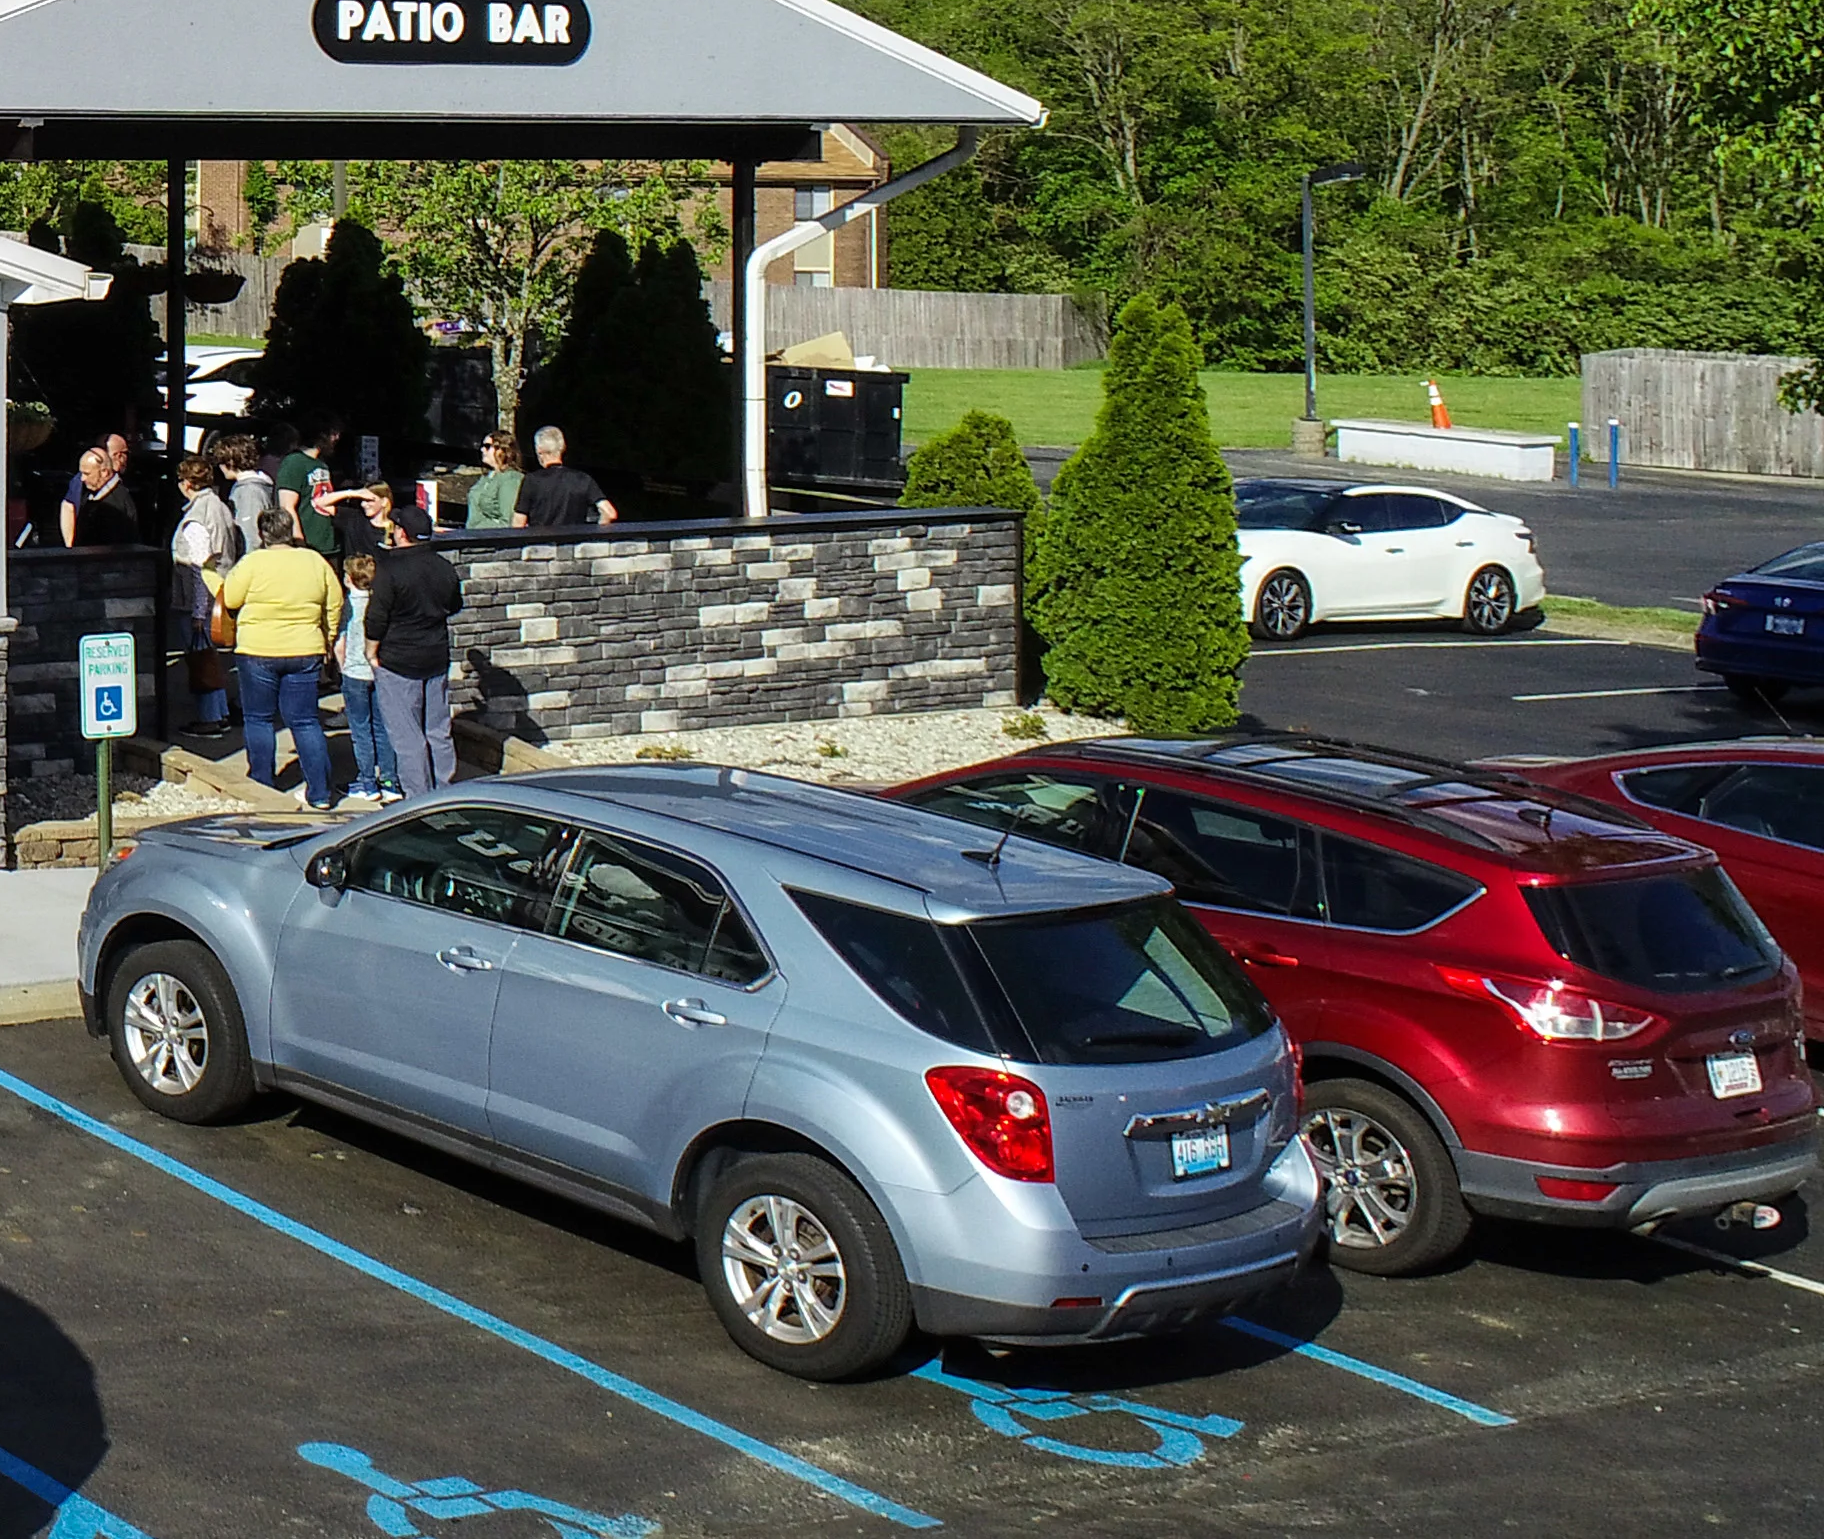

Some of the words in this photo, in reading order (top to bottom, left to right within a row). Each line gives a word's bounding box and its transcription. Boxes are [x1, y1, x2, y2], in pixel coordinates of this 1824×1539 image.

[336, 0, 465, 43] PATIO
[488, 1, 571, 44] BAR
[86, 644, 130, 658] RESERVED
[88, 662, 128, 676] PARKING
